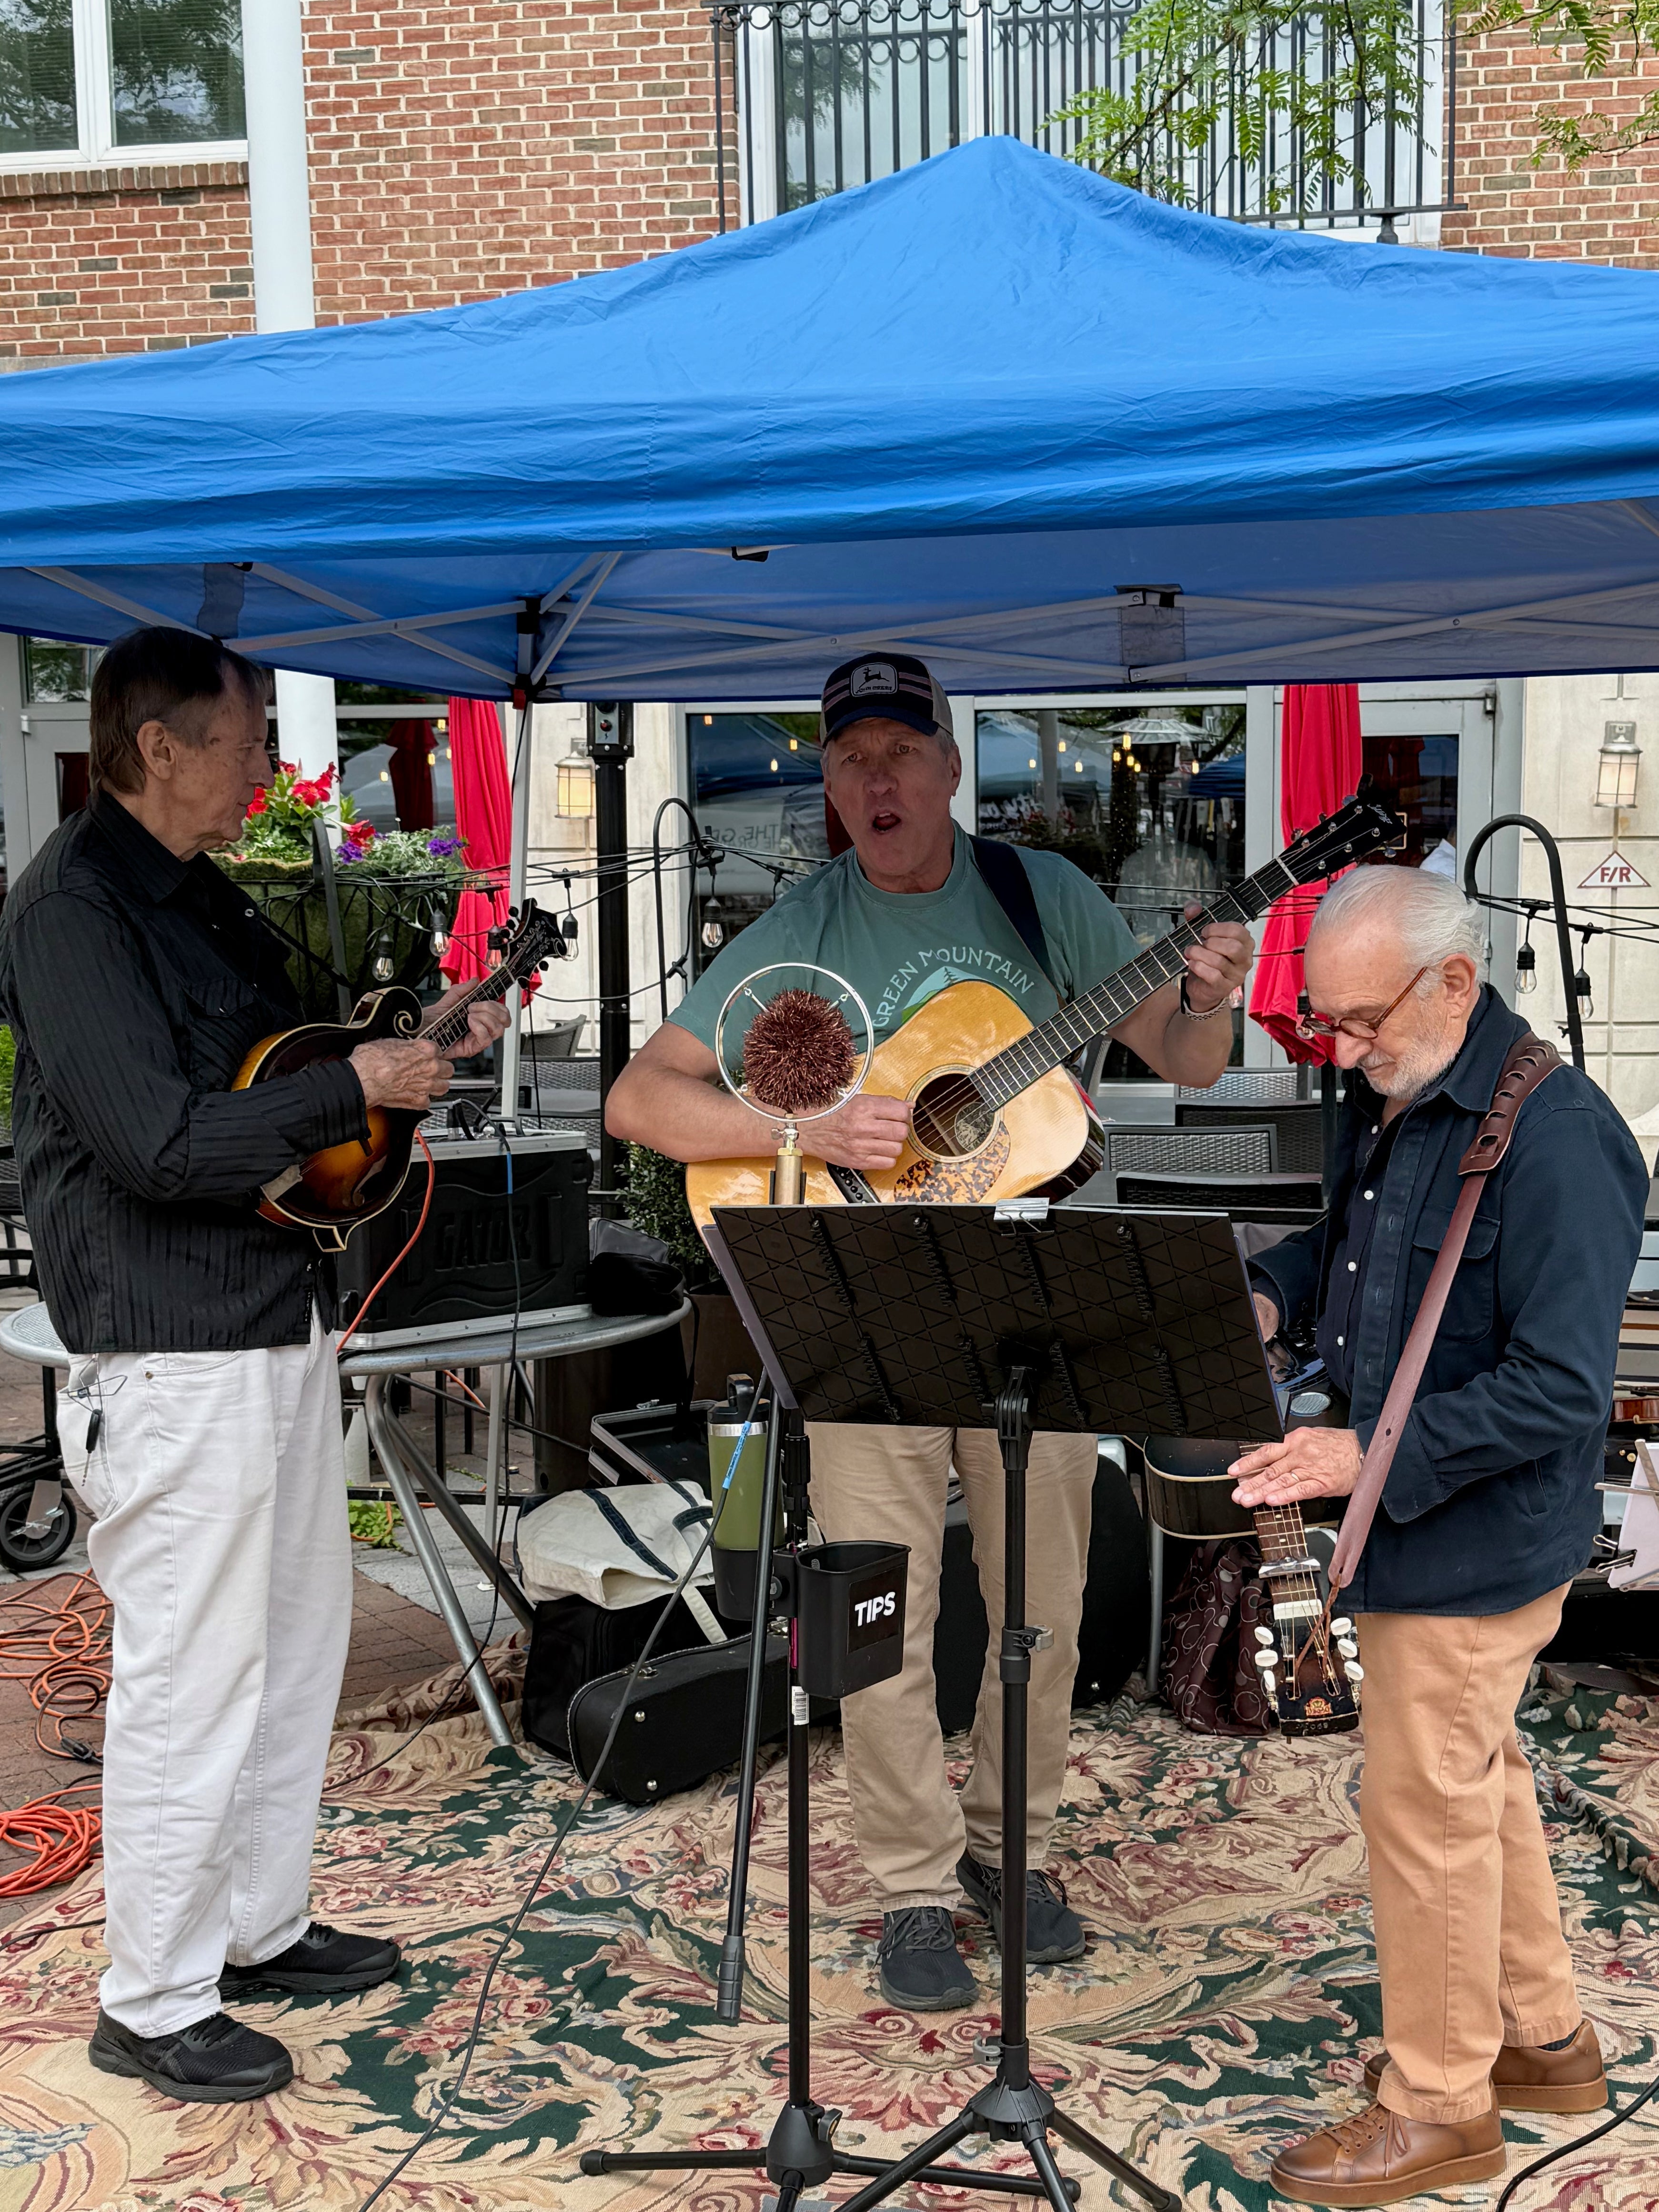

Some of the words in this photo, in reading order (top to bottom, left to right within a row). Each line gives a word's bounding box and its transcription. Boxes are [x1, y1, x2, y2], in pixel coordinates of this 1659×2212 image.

[1600, 867, 1631, 883] F/R
[872, 961, 918, 1027] GREEN
[918, 946, 1035, 994] MOUNTAIN
[434, 1206, 531, 1272] GATOR
[855, 1591, 895, 1627] TIPS
